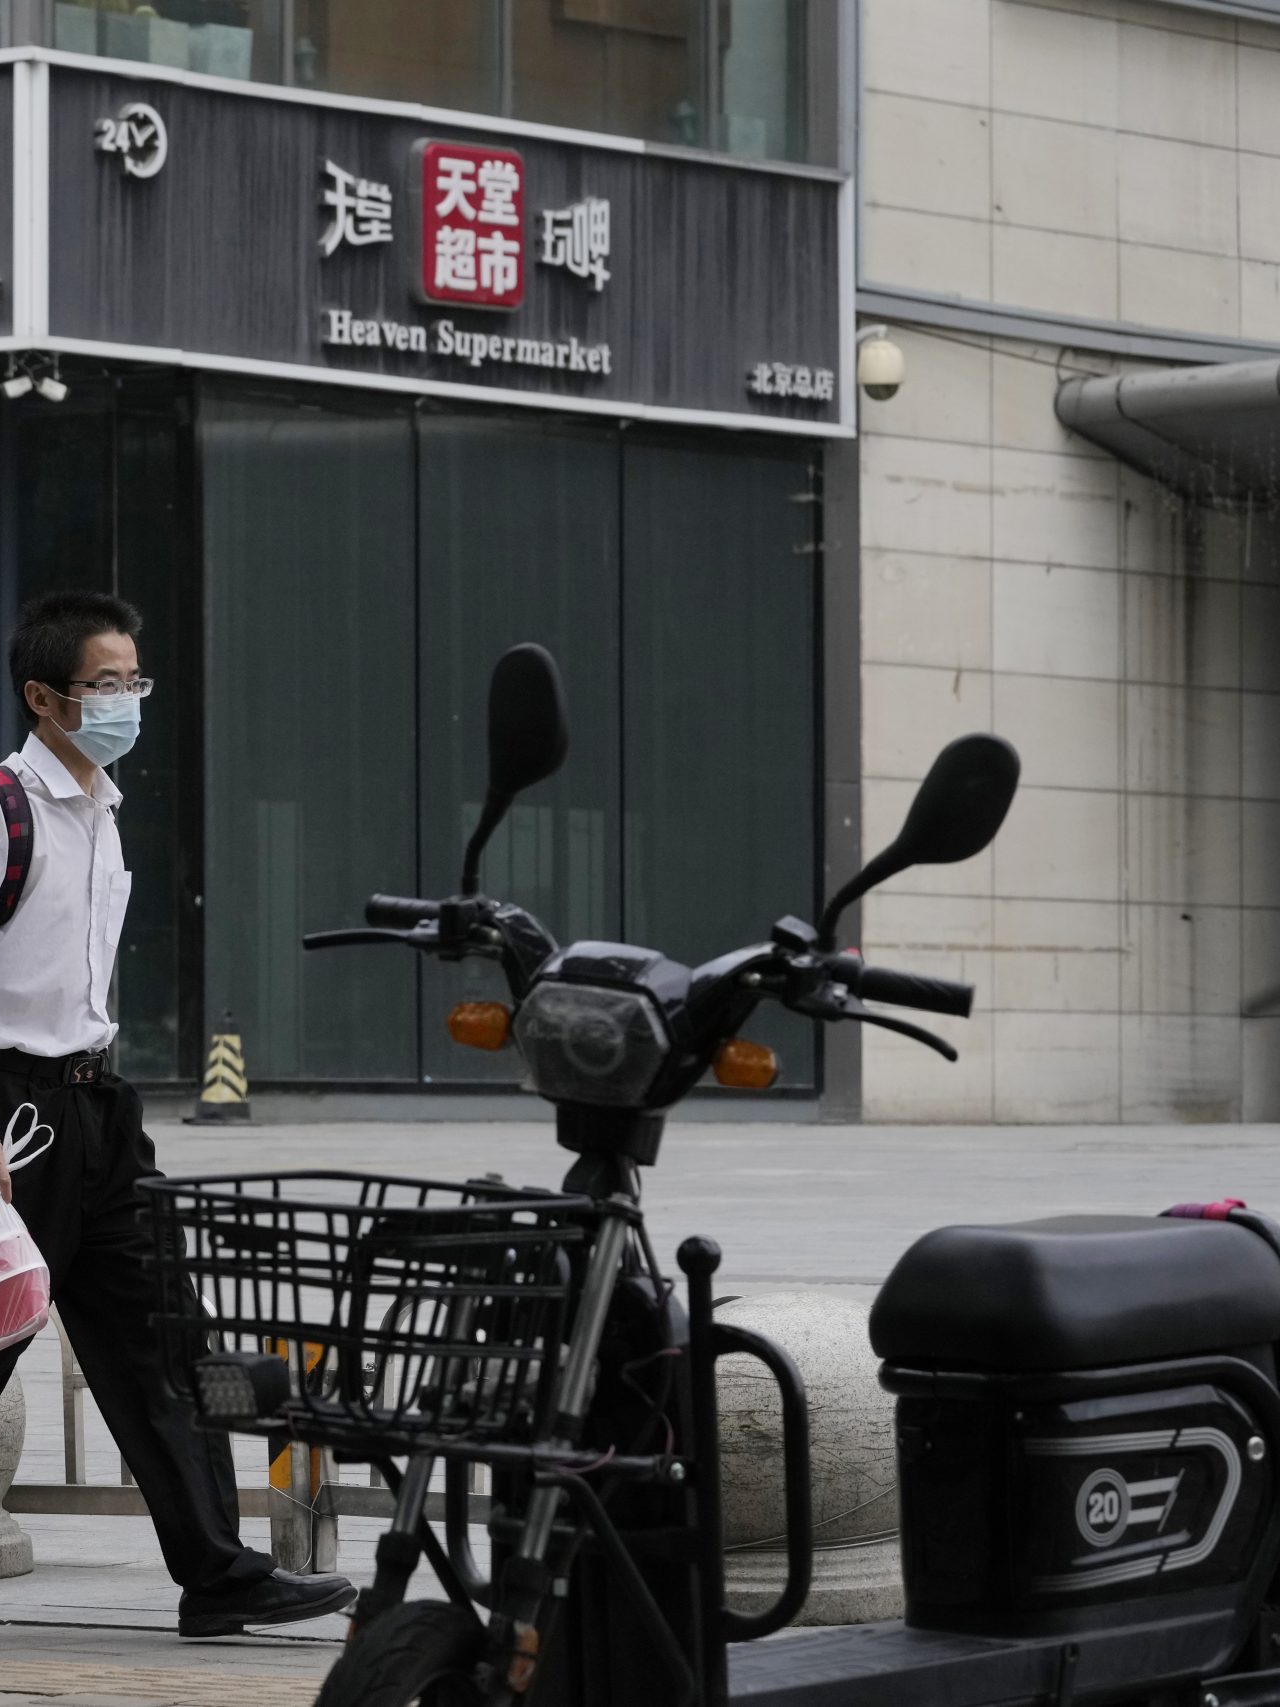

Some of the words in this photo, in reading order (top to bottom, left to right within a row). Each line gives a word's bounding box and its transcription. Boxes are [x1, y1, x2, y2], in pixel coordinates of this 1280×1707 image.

[434, 154, 520, 226] 天堂
[434, 224, 520, 297] 超市
[328, 308, 428, 352] Heaven
[436, 318, 613, 375] Supermarket
[750, 361, 835, 401] 北京总店
[1087, 1491, 1119, 1526] 20
